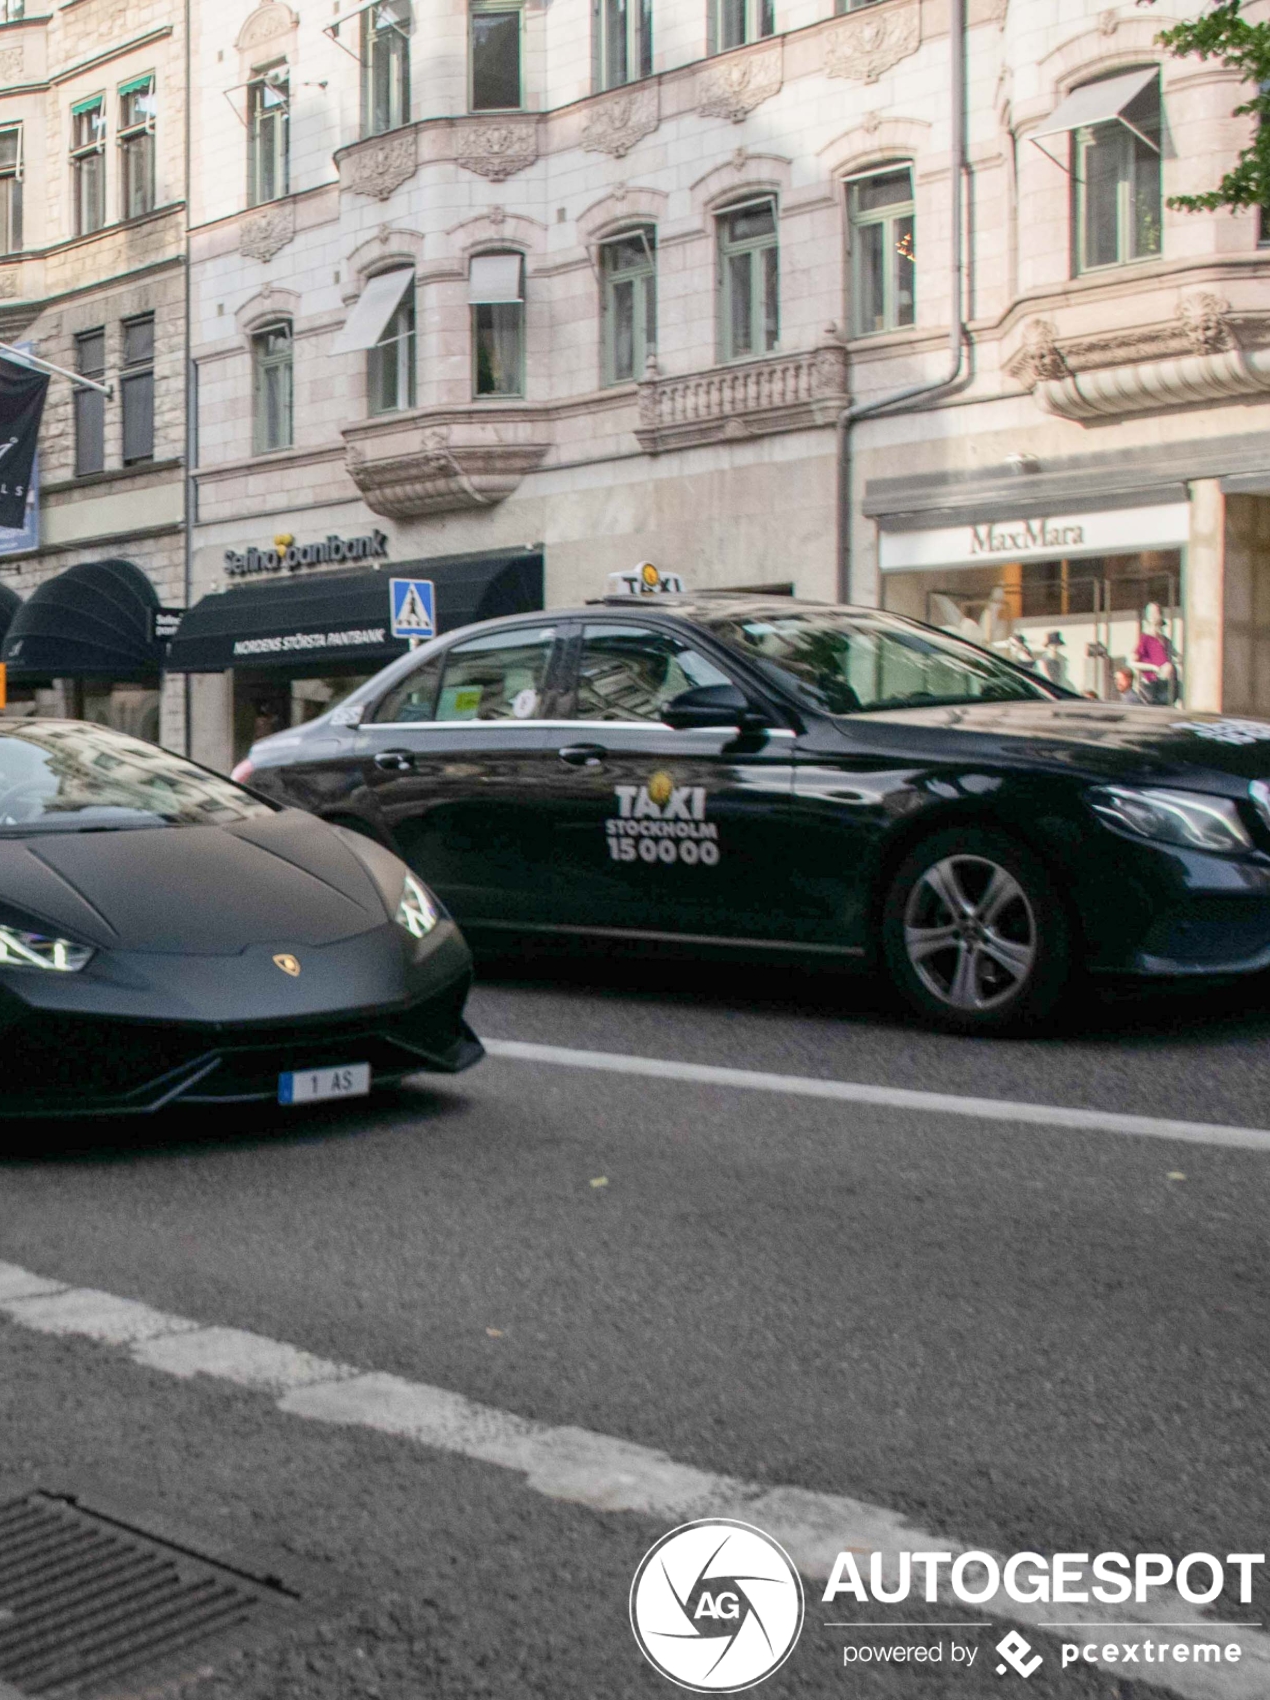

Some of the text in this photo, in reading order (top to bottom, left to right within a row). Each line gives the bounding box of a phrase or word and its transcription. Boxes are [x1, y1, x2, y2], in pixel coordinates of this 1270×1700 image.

[969, 517, 1085, 555] MaxMara
[327, 627, 386, 647] PANTBANK
[614, 784, 708, 821] TAXI
[605, 818, 719, 840] STOCKHOLM
